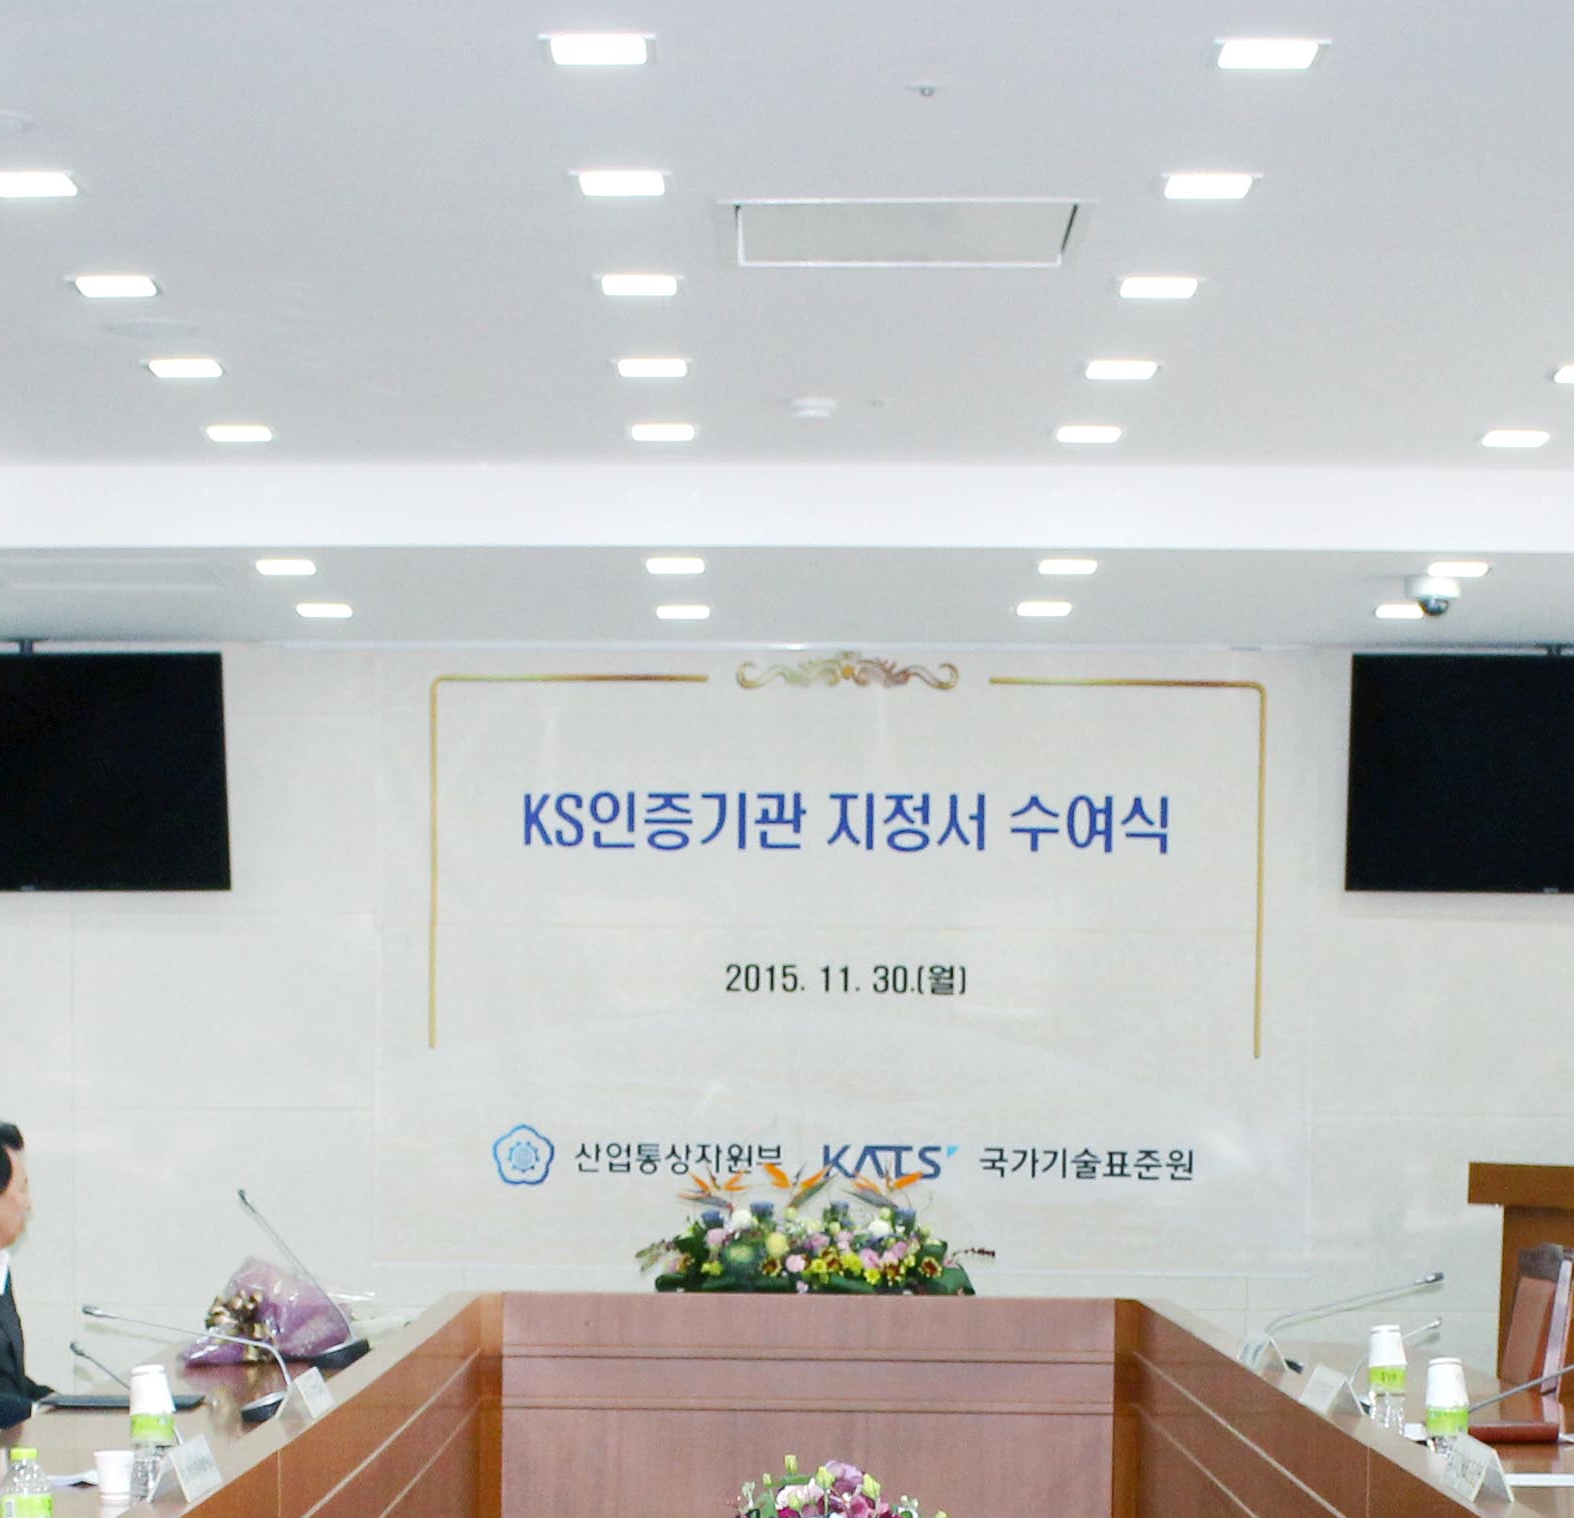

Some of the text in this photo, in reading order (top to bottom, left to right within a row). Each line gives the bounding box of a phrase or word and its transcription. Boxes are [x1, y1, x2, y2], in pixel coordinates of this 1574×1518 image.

[523, 790, 1169, 855] KS인증기관 지정서 수여식
[725, 963, 967, 996] 2015. 11. 30.(월)
[574, 1142, 784, 1176] 산업통상자원부
[821, 1143, 1195, 1183] KATS 국가기술표준원
